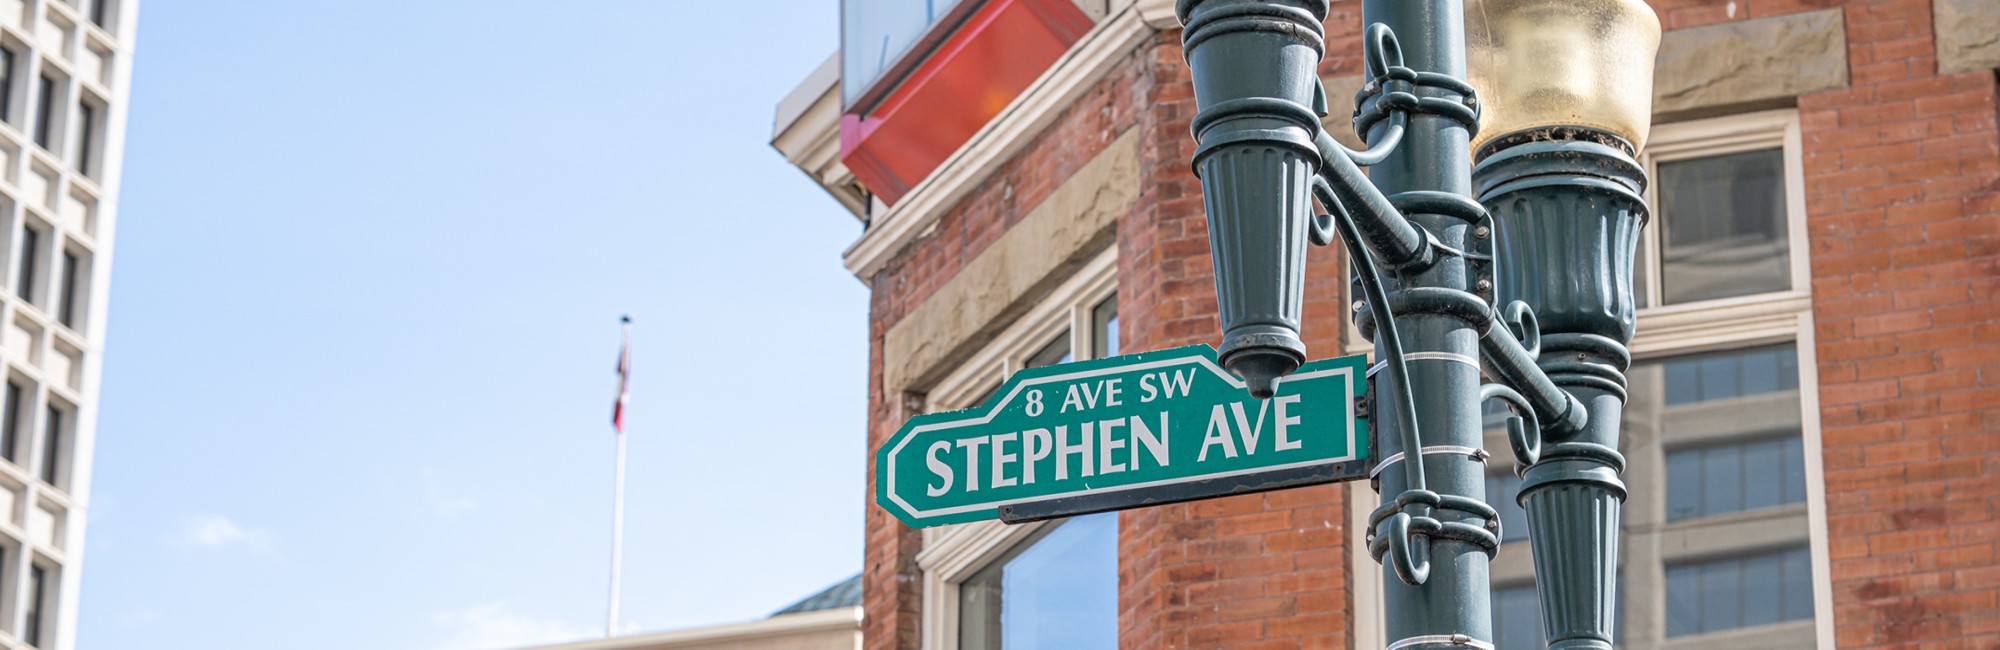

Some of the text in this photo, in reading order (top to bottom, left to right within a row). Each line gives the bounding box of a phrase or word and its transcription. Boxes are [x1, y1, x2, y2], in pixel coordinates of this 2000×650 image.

[1024, 367, 1197, 418] 8 AVE SW
[926, 394, 1302, 498] STEPHEN AVE
